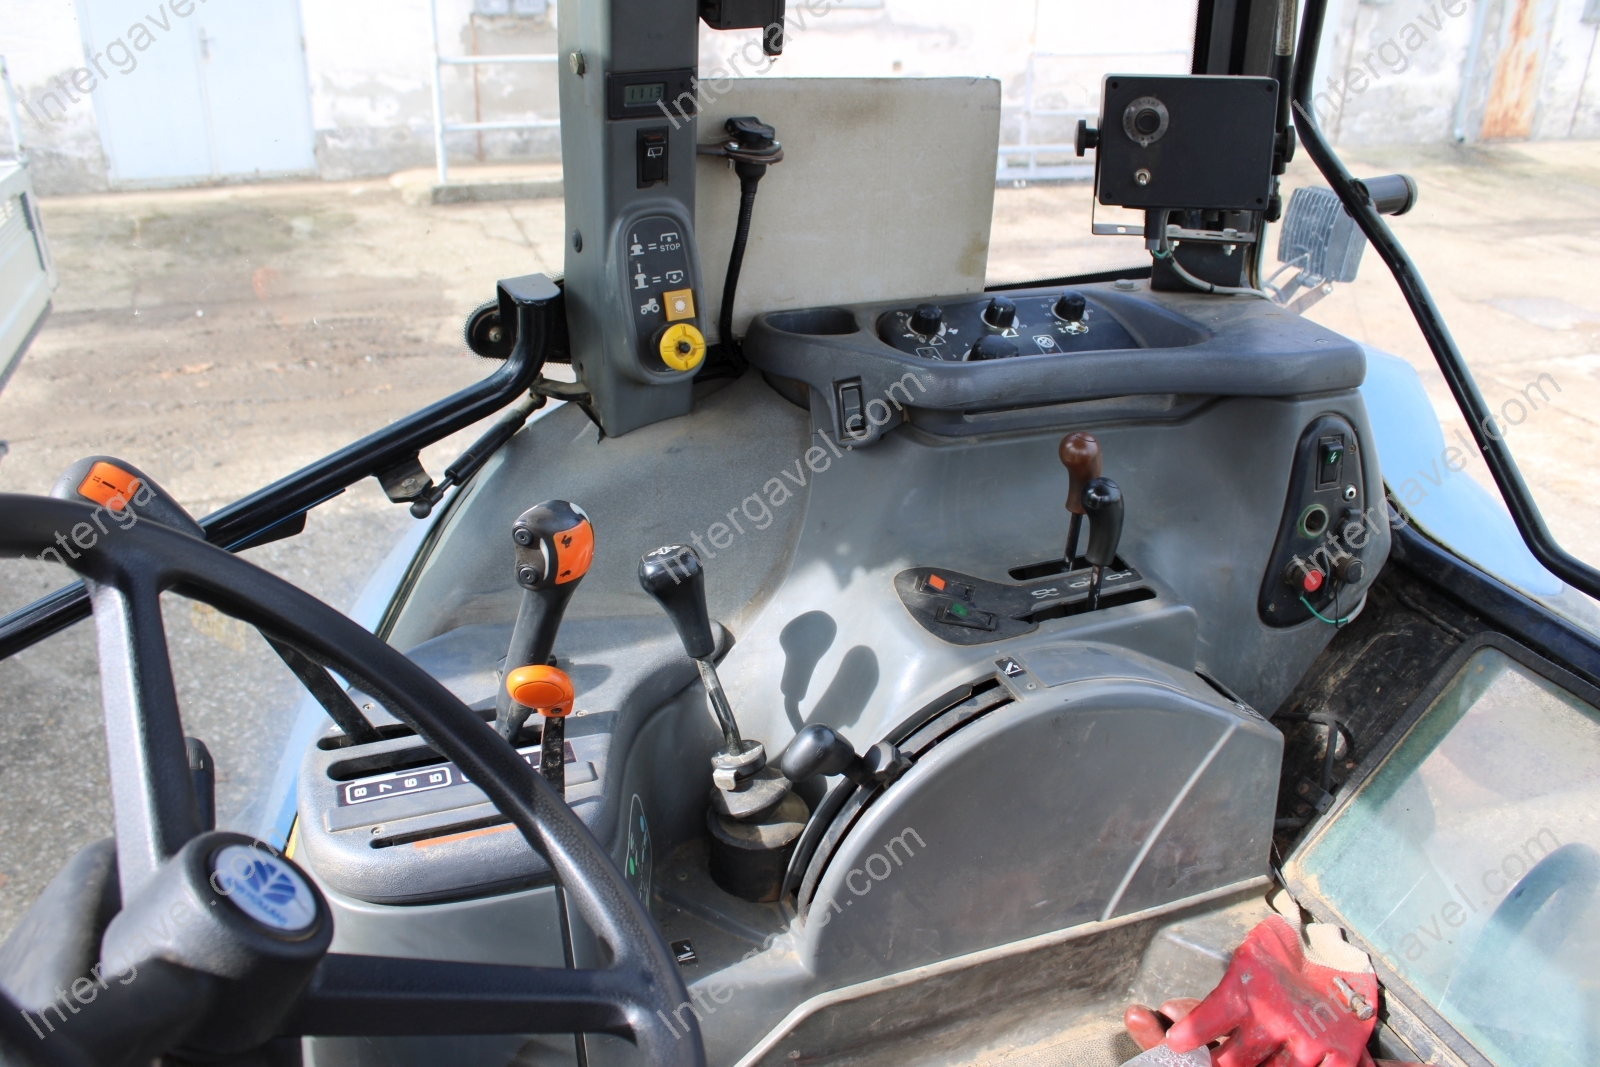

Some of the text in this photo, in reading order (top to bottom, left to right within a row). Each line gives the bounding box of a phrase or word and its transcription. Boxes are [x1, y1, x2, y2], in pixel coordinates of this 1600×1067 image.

[659, 243, 681, 252] STOP
[404, 777, 418, 788] 6
[429, 773, 443, 784] 5
[353, 787, 367, 798] 8
[379, 782, 393, 793] 7
